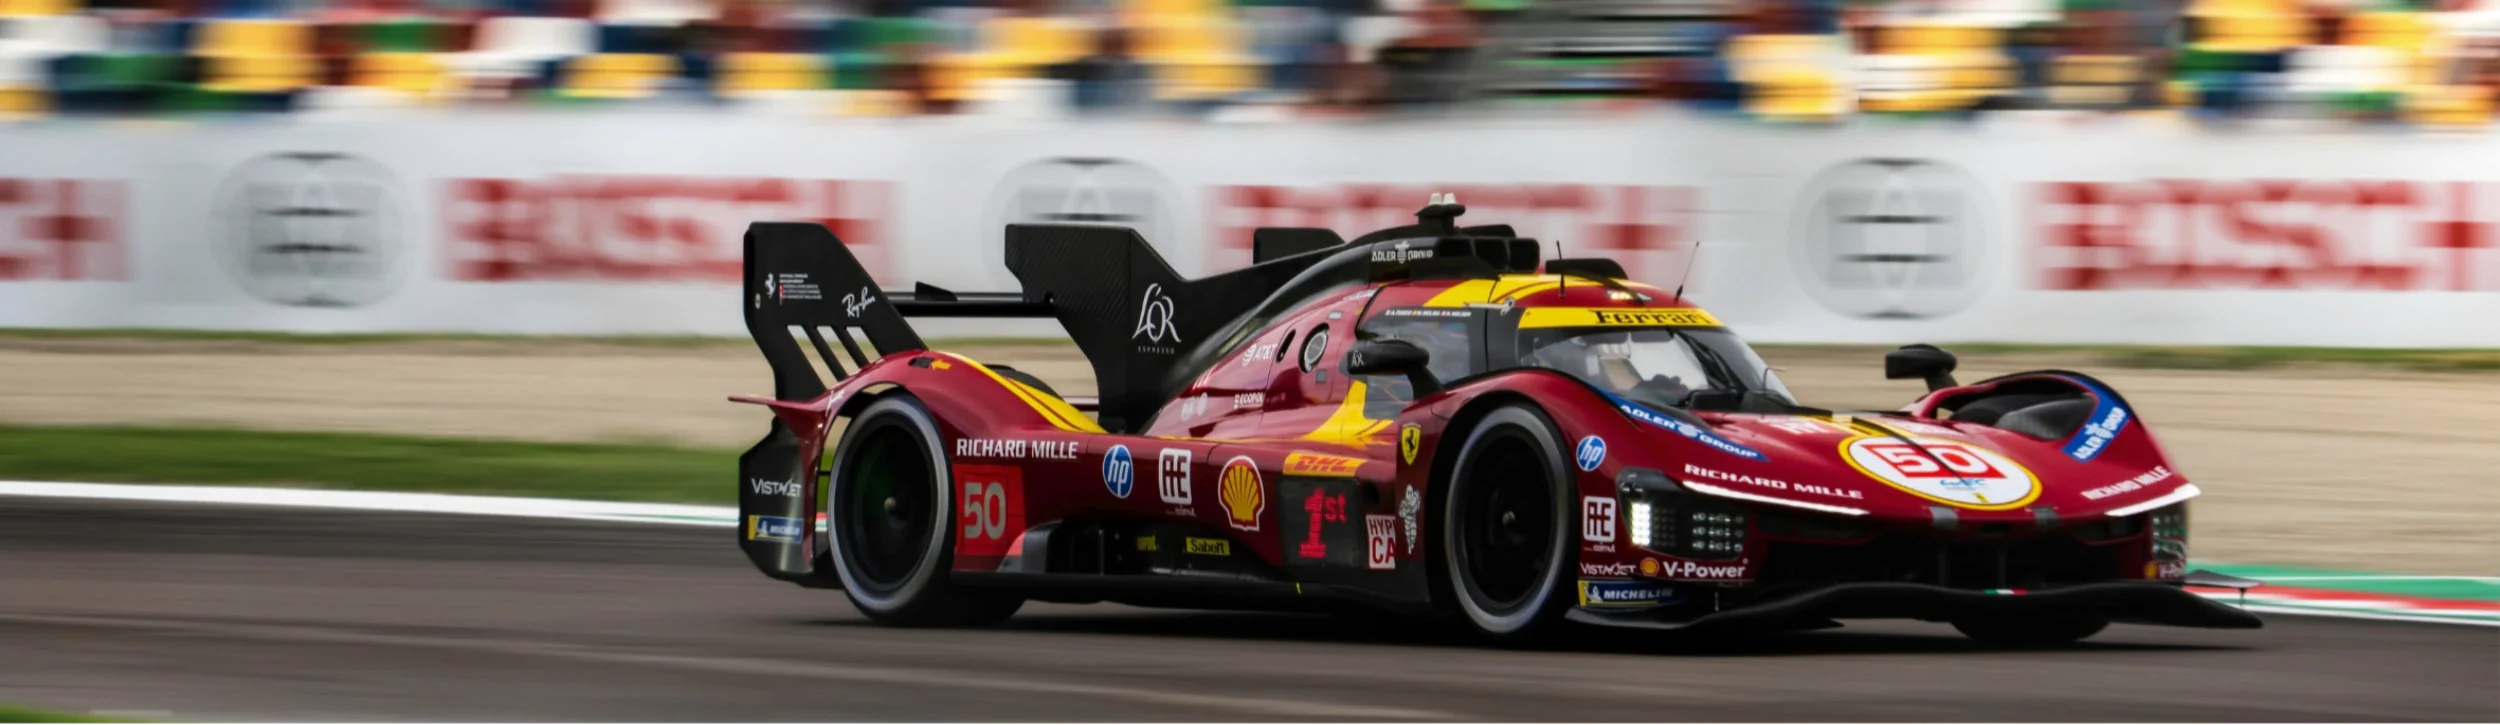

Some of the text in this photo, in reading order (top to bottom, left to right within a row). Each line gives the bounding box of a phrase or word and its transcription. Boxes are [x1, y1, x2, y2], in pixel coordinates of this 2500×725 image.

[1371, 251, 1397, 262] ADLER
[1589, 308, 1713, 325] Ferrari
[1620, 405, 1757, 458] ADLER GROUP
[956, 438, 1079, 459] RICHARD MILLE
[1873, 446, 1989, 474] 50
[1293, 456, 1348, 472] DHL
[1684, 464, 1863, 499] RICHARD MILLE
[964, 481, 1006, 540] 50
[1299, 488, 1347, 558] 1st
